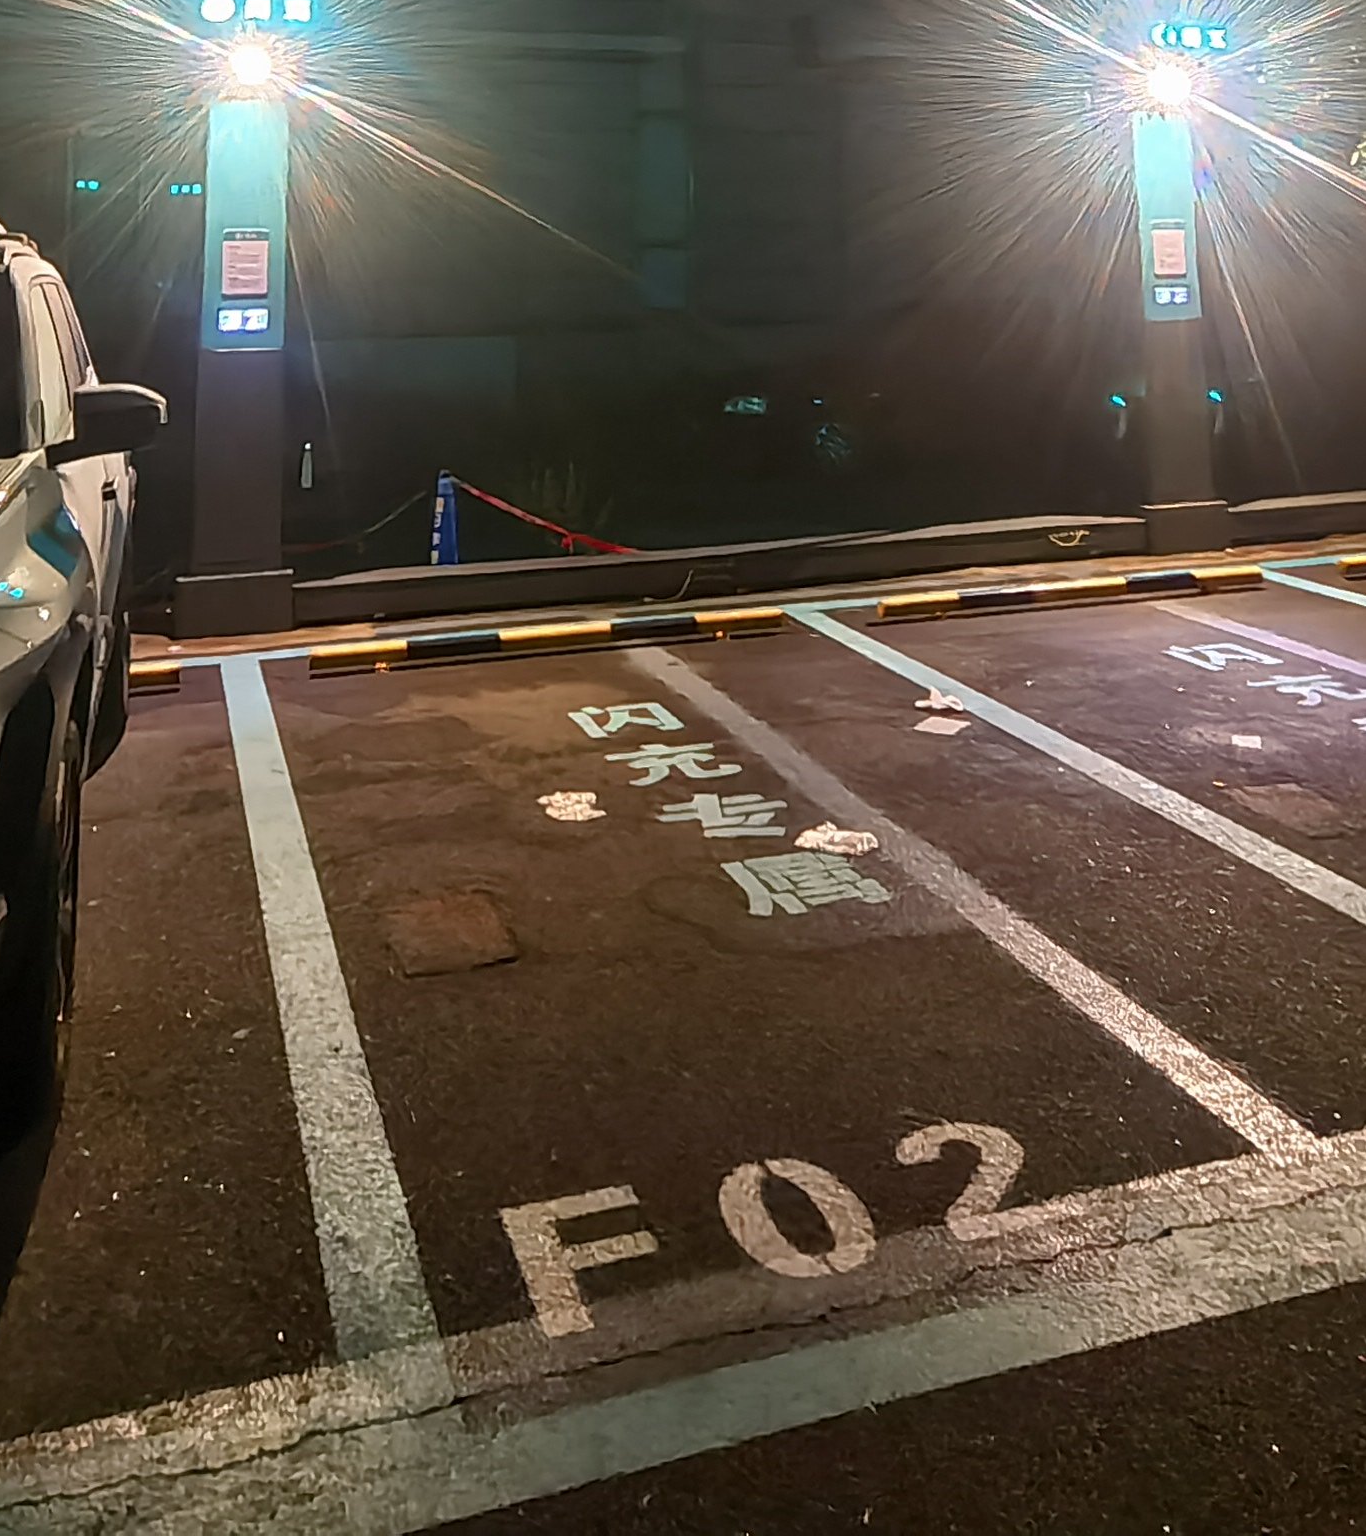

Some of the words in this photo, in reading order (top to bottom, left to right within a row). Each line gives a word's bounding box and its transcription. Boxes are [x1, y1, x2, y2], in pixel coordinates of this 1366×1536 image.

[567, 701, 892, 917] 闪充专属
[499, 1120, 1047, 1339] F02
